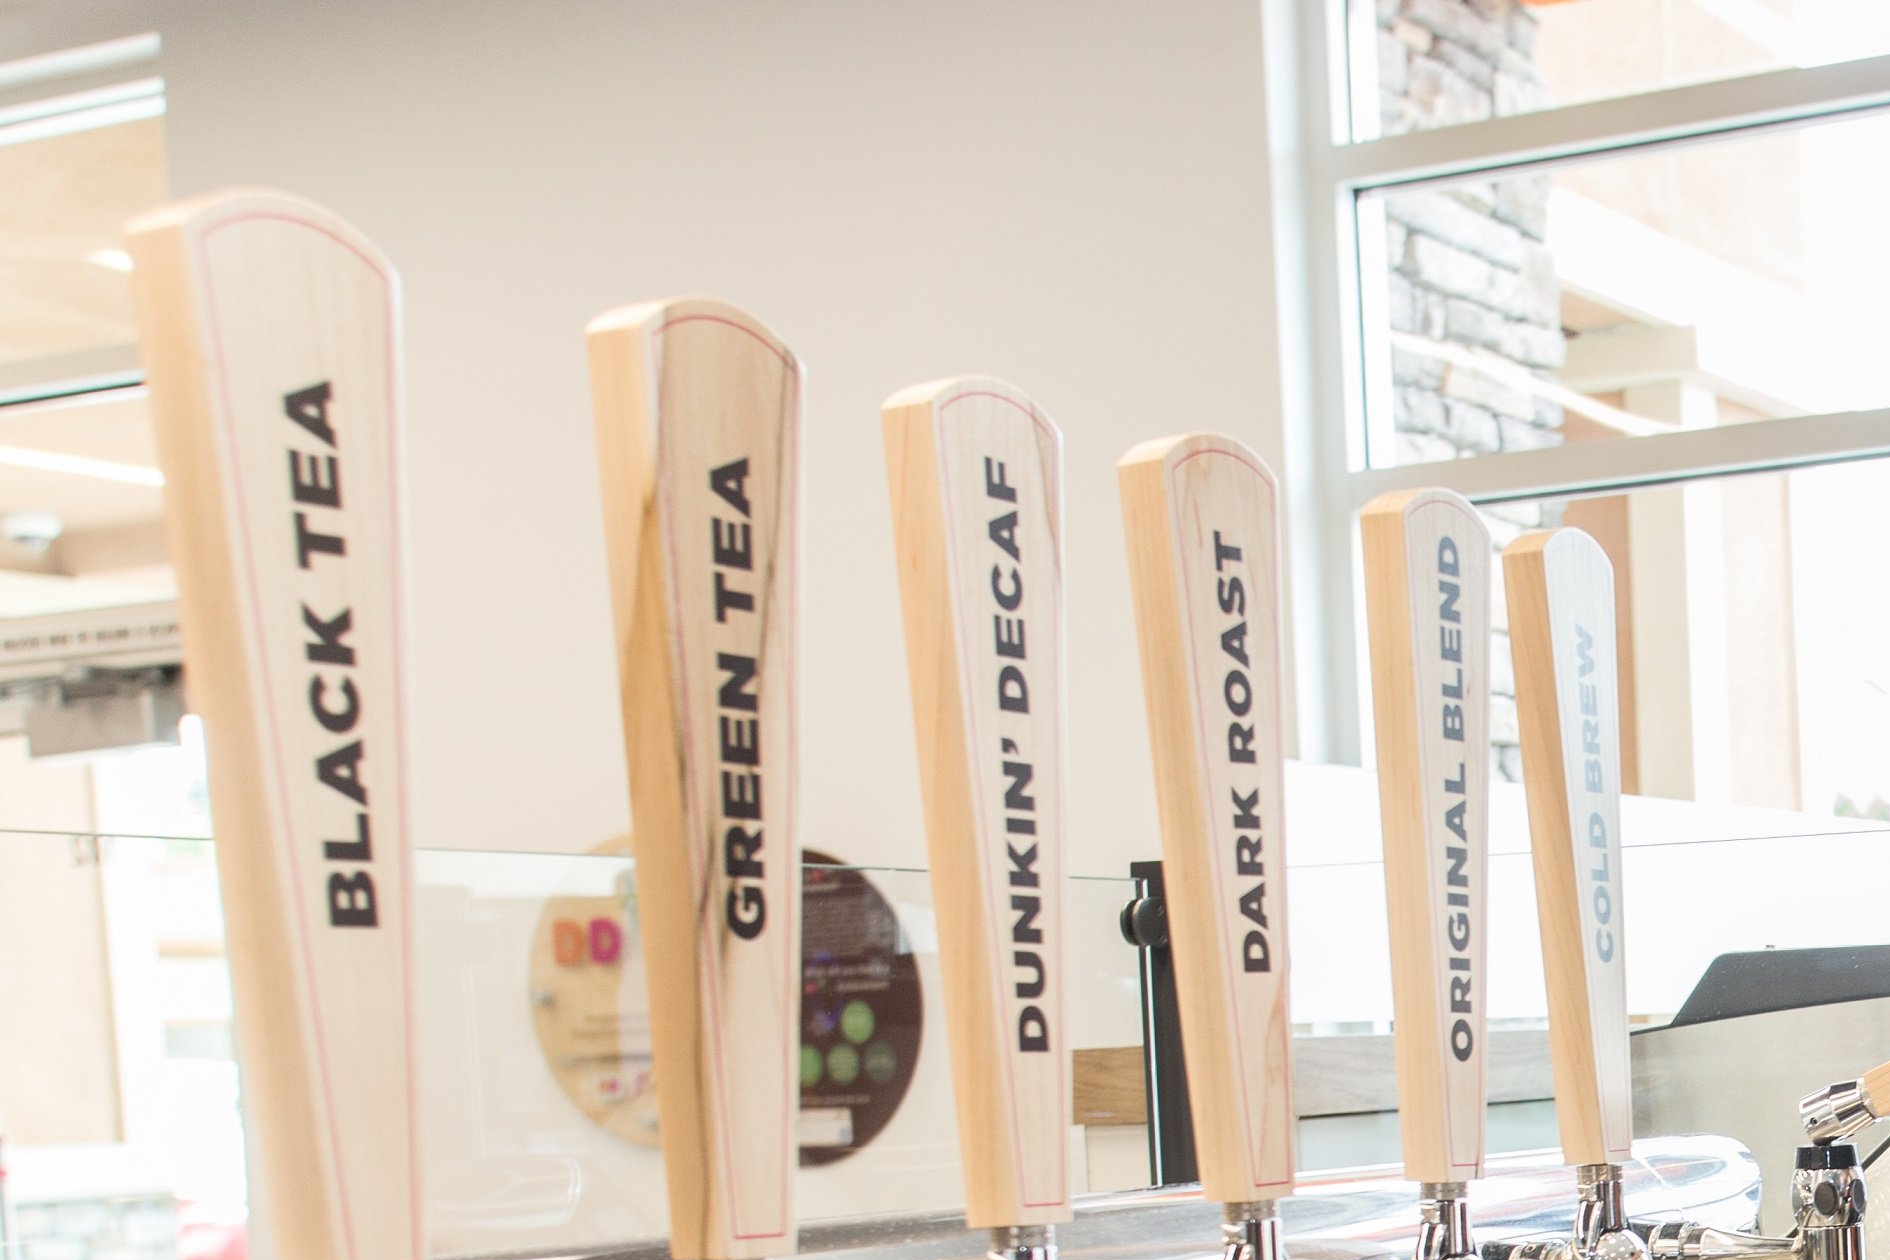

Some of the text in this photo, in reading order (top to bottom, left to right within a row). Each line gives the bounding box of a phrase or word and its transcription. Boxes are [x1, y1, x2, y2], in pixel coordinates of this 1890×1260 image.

[282, 380, 379, 928] BLACK TEA
[709, 458, 767, 940] GREEN TEA
[985, 456, 1030, 715] DECAF
[1213, 530, 1272, 973] DARK ROAST
[1437, 535, 1474, 1062] ORIGINAL BLEND
[1574, 622, 1616, 964] COLD BREW
